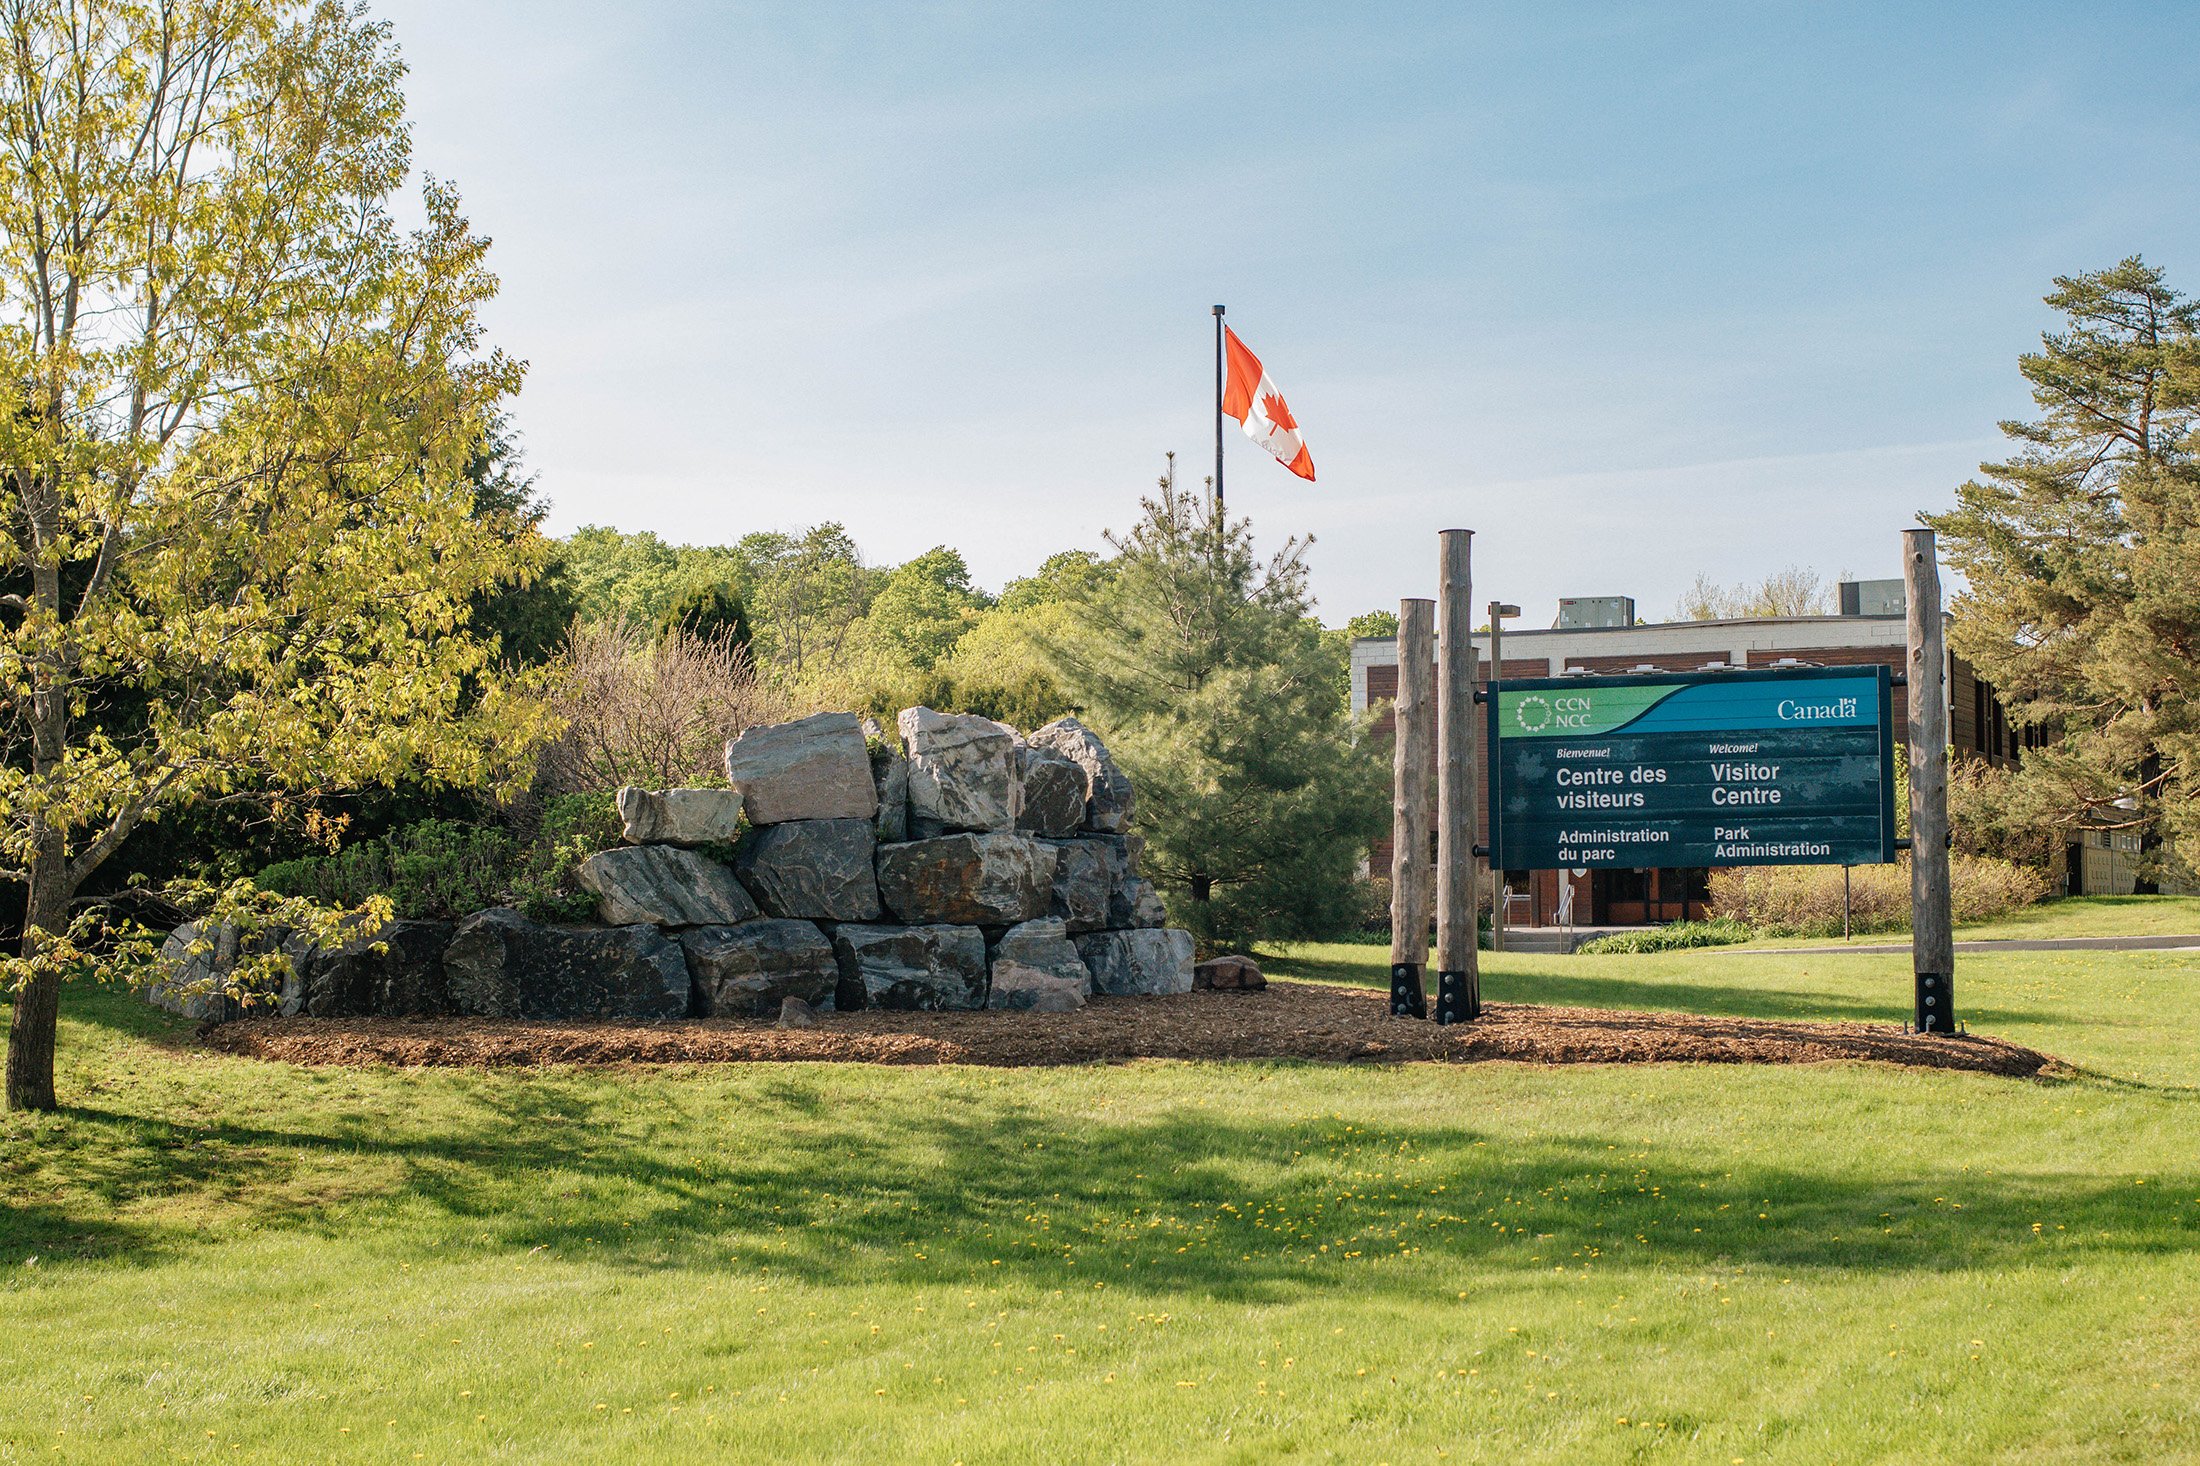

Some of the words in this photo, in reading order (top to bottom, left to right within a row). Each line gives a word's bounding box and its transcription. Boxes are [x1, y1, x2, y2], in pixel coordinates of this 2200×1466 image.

[1555, 697, 1591, 712] CCN
[1777, 698, 1857, 721] Canada
[1555, 713, 1591, 728] NCC
[1556, 747, 1610, 759] Bienvenue!
[1709, 743, 1758, 754] Welcome!
[1556, 768, 1624, 786] Centre
[1629, 765, 1667, 783] des
[1710, 763, 1780, 781] Visitor
[1556, 791, 1645, 809] visiteurs
[1711, 787, 1781, 805] Centre
[1558, 829, 1669, 844] Administration
[1714, 826, 1749, 840] Park
[1558, 847, 1577, 860] du
[1582, 849, 1615, 863] parc
[1715, 842, 1830, 857] Administration
